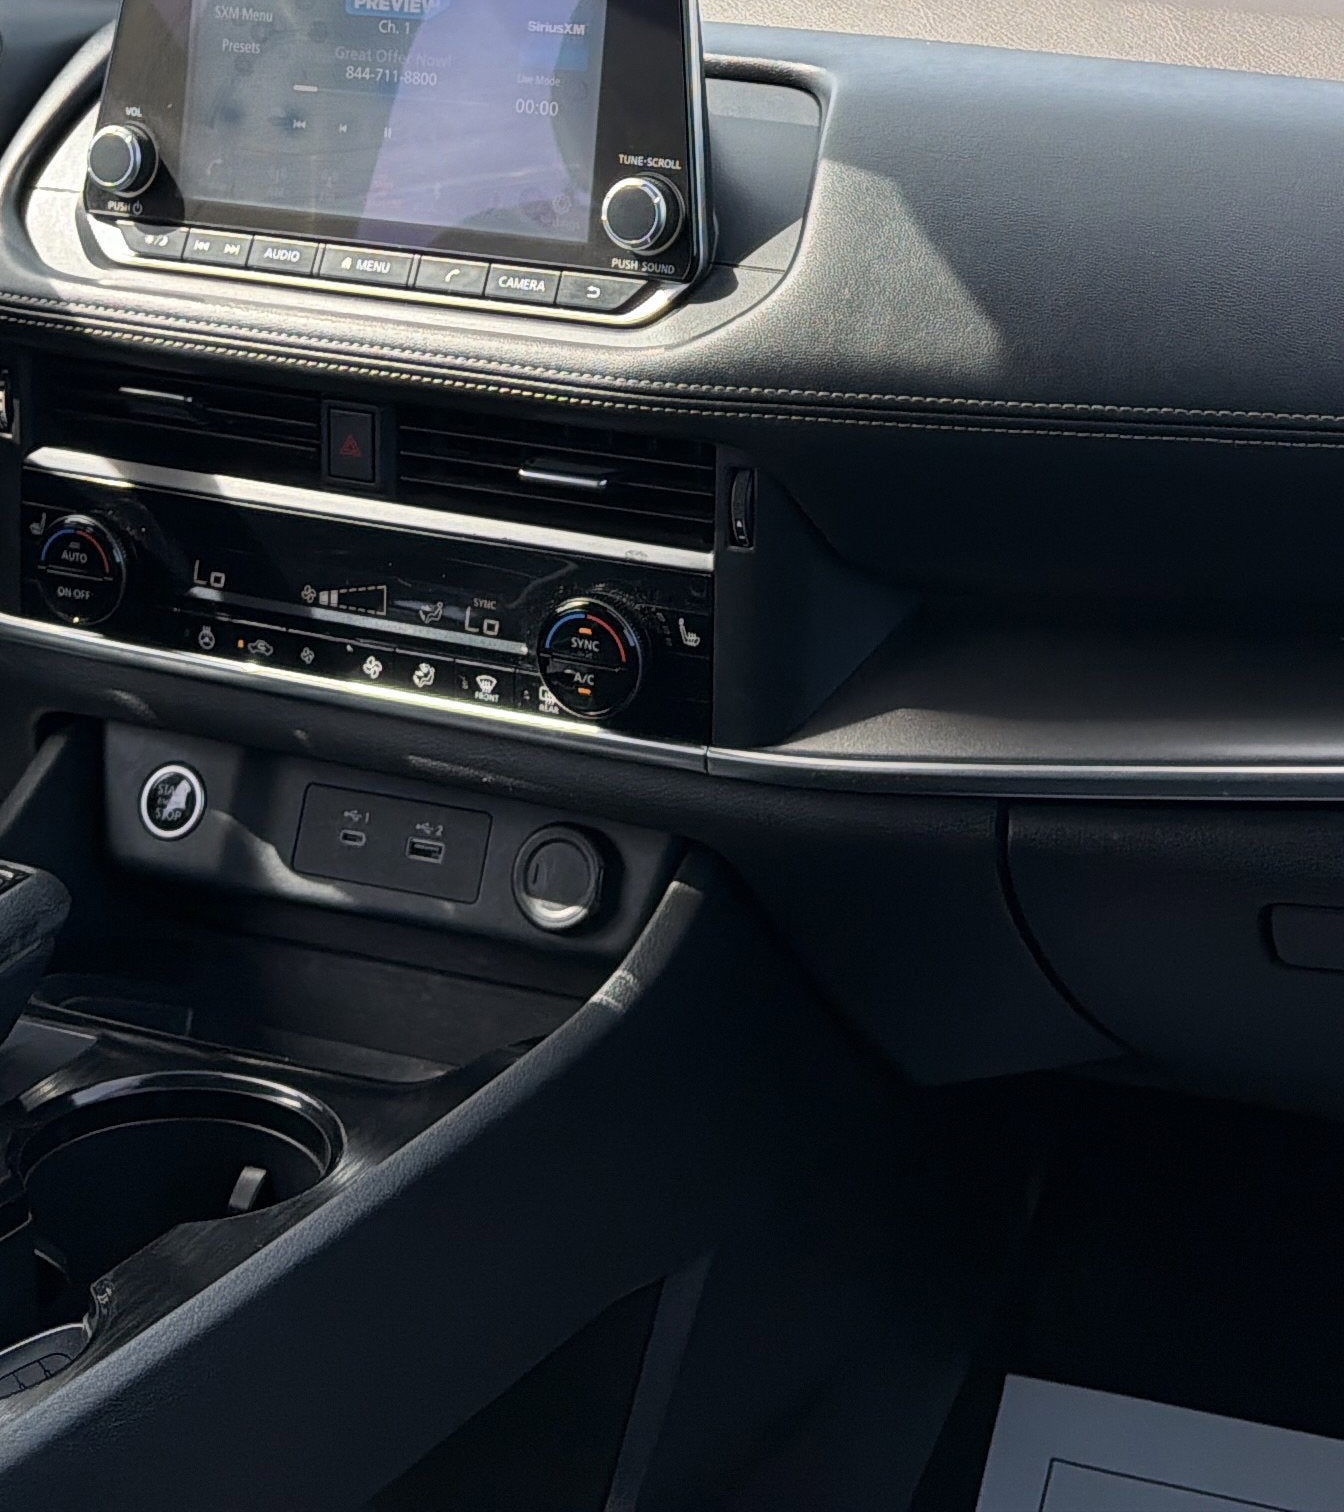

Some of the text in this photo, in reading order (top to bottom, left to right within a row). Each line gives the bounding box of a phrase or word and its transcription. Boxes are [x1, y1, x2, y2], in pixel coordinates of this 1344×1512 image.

[215, 5, 273, 22] SXM Menu
[378, 19, 411, 35] Ch. 1
[221, 38, 261, 55] Presets
[335, 46, 372, 62] Great
[376, 49, 409, 65] Offer
[345, 65, 438, 87] 844-711-8800
[535, 75, 561, 87] Mode
[125, 106, 142, 118] VOL
[515, 98, 559, 116] 00:00
[107, 200, 131, 212] PUSH
[263, 246, 301, 263] AUDIO
[356, 259, 391, 274] MENU
[611, 257, 675, 275] PUSH SOUND
[498, 276, 546, 293] CAMERA
[60, 549, 88, 564] AUTO
[193, 559, 226, 588] Lo
[57, 585, 91, 601] ON OFF
[473, 597, 497, 611] SYNC
[464, 606, 500, 636] Lo
[570, 637, 600, 653] SYNC
[573, 672, 595, 686] A/C
[474, 690, 500, 703] FRONT
[435, 824, 444, 836] 2
